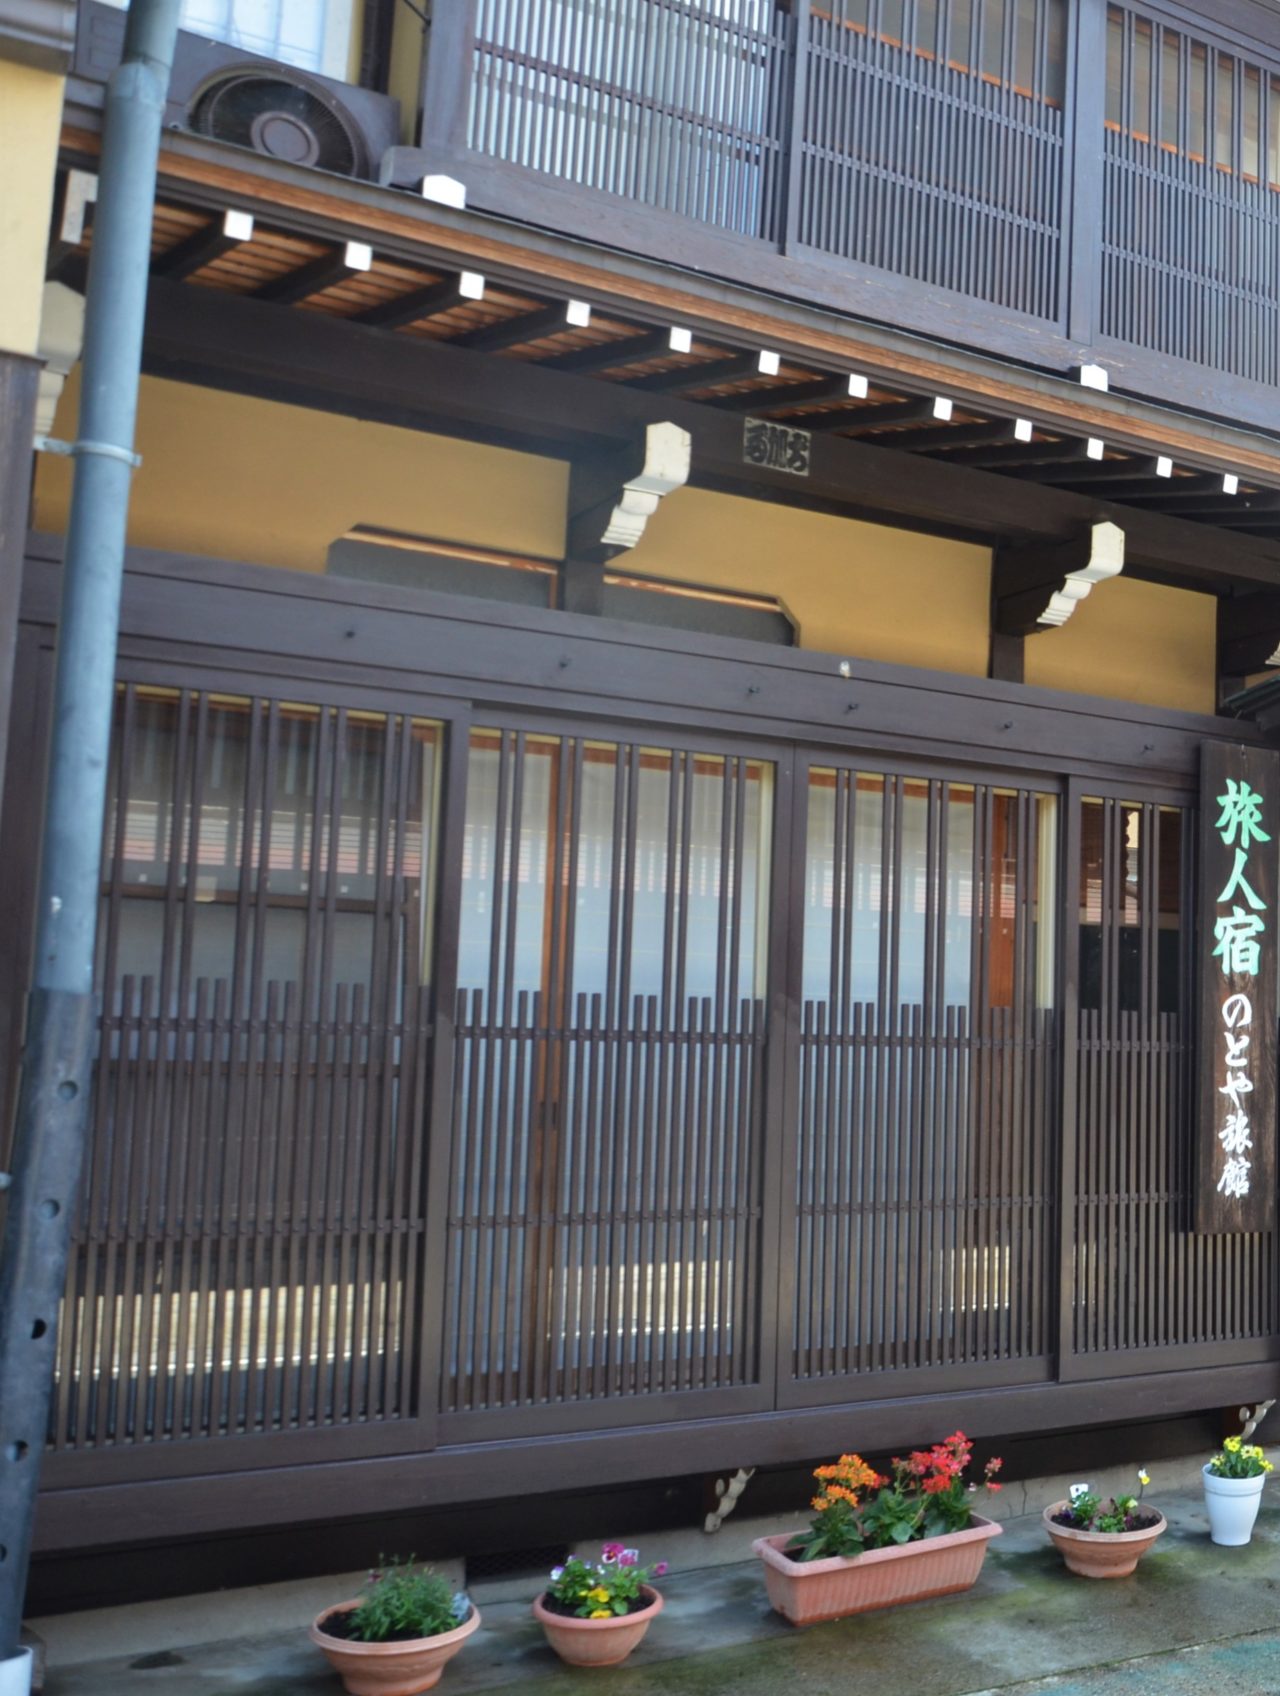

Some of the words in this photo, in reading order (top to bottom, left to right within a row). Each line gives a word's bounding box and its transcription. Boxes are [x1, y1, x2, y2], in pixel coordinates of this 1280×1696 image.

[1211, 778, 1272, 976] 旅人宿
[1217, 994, 1254, 1198] のとや旅館
